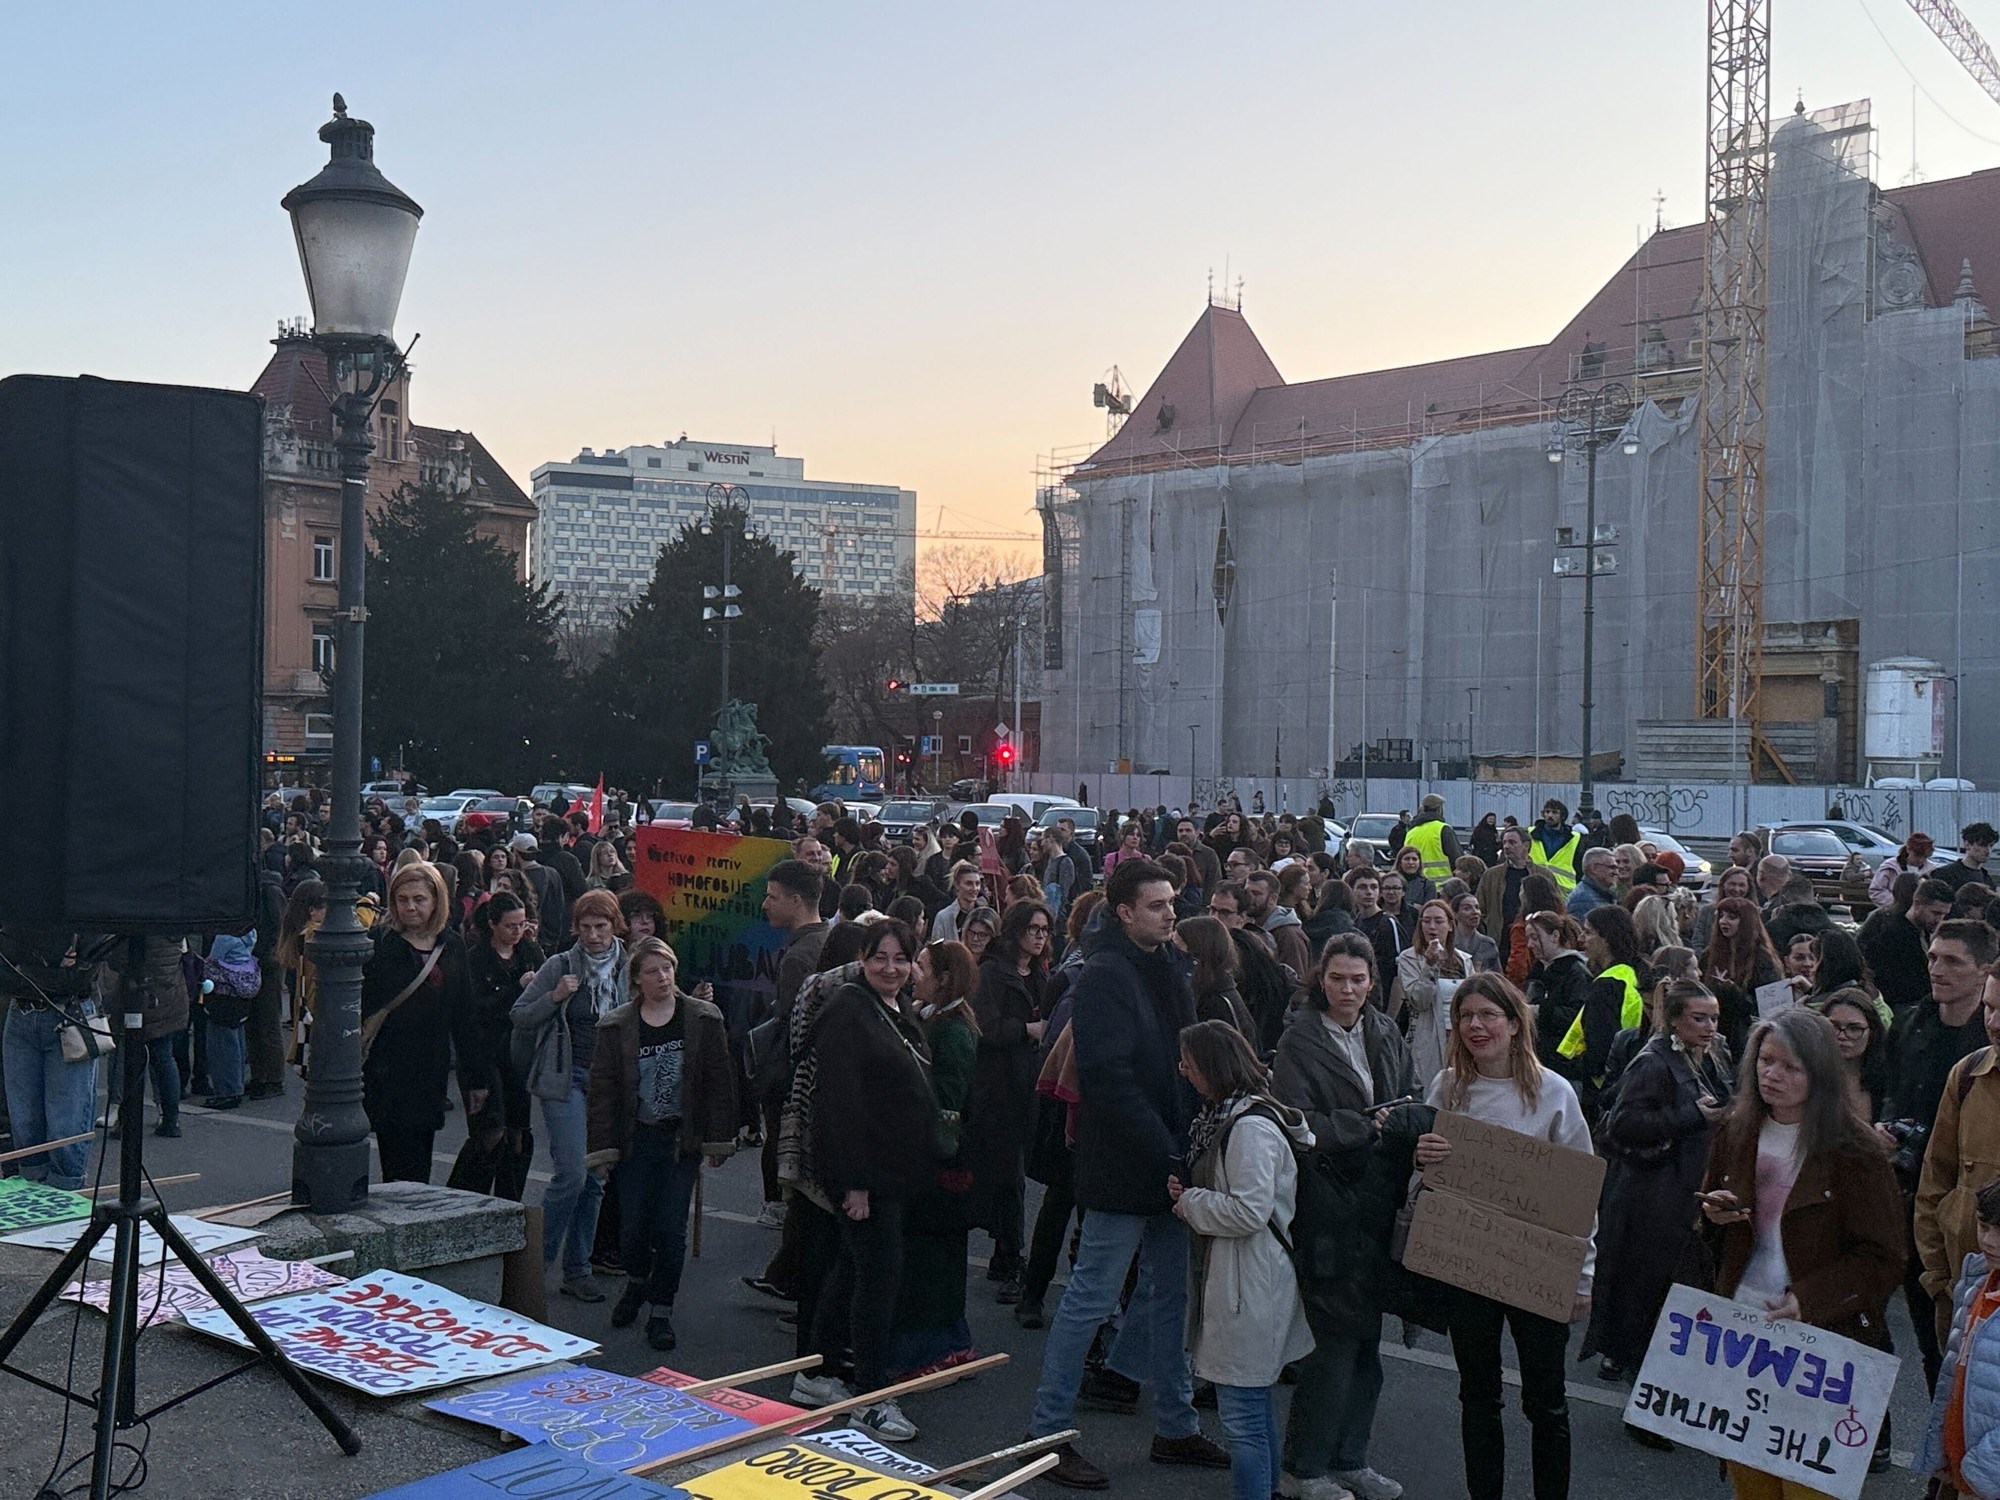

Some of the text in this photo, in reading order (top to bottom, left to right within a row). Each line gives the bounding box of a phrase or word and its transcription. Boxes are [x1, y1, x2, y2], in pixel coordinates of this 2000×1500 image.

[704, 451, 750, 465] WESTIN
[1504, 1138, 1553, 1169] SAM
[1732, 1311, 1758, 1324] are
[1799, 1332, 1817, 1344] as
[1669, 1312, 1854, 1406] FEMALE
[1634, 1382, 1836, 1475] THE FUTURE
[744, 1447, 882, 1493] DOBRO
